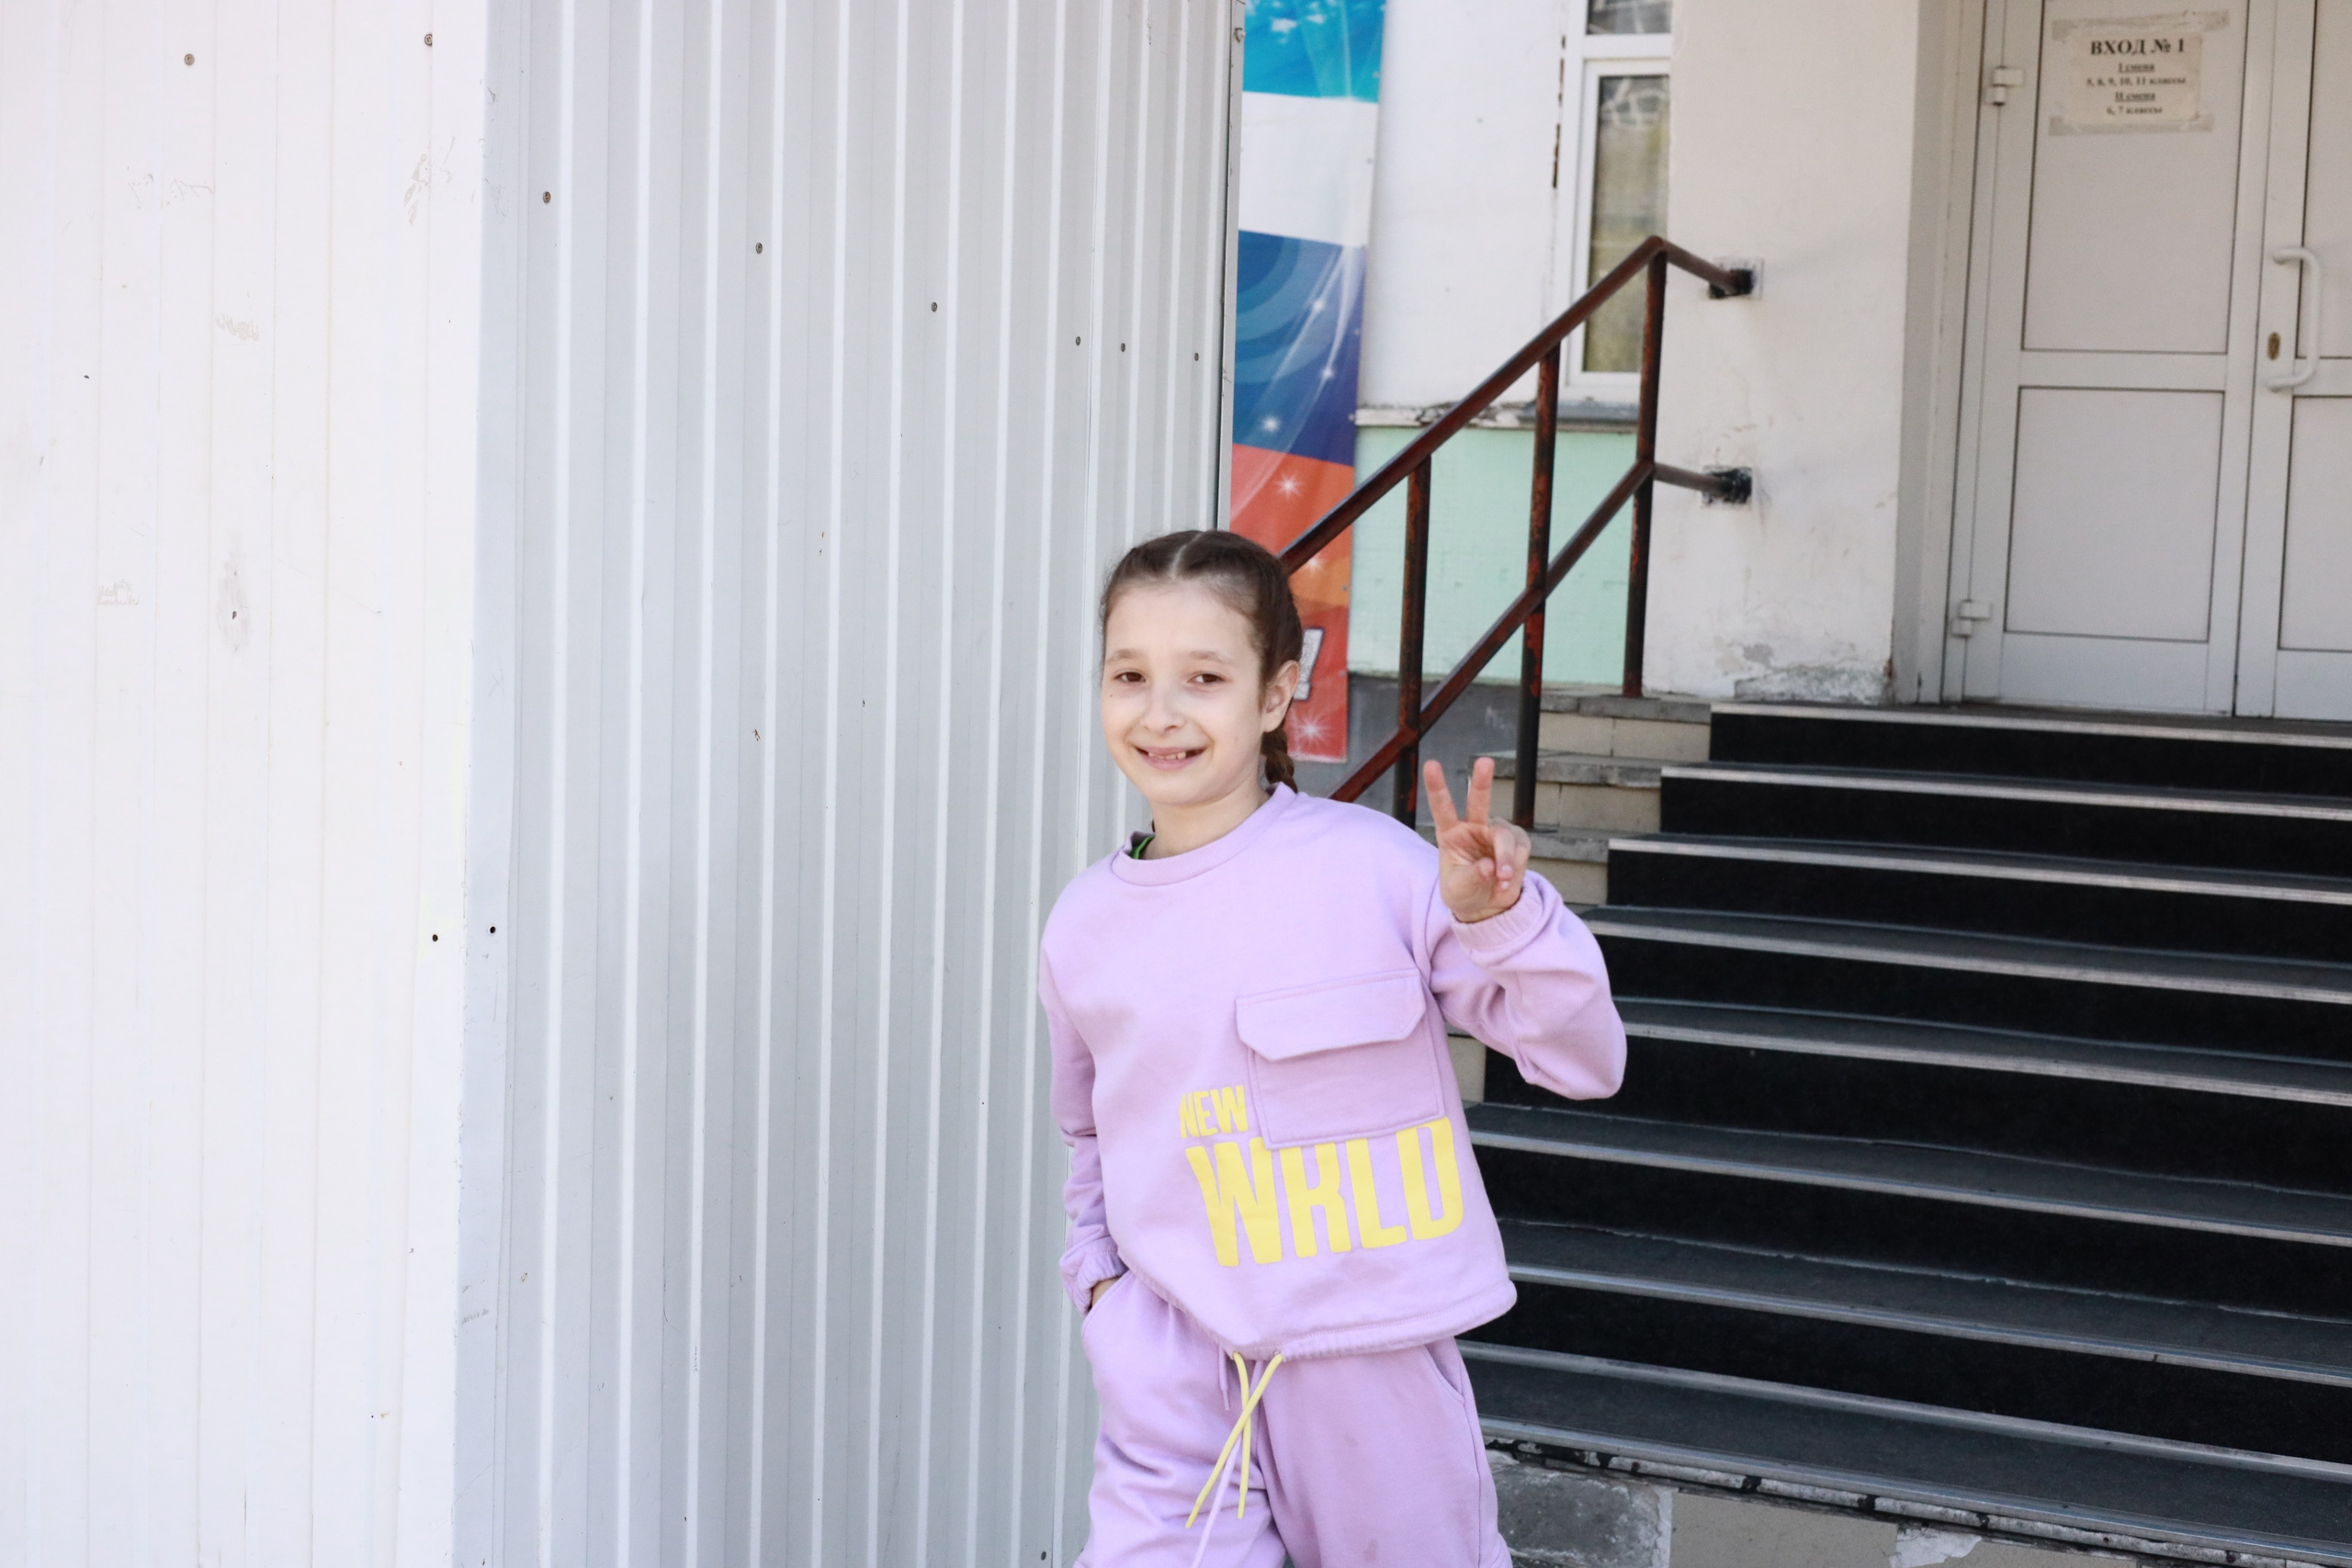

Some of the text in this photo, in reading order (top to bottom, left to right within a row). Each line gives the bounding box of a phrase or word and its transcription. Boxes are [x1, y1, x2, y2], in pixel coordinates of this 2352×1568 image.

[2089, 38, 2185, 55] ВХОД № 1
[2136, 76, 2146, 85] 11
[1179, 1085, 1249, 1139] NEW
[1185, 1116, 1464, 1268] WRLD
